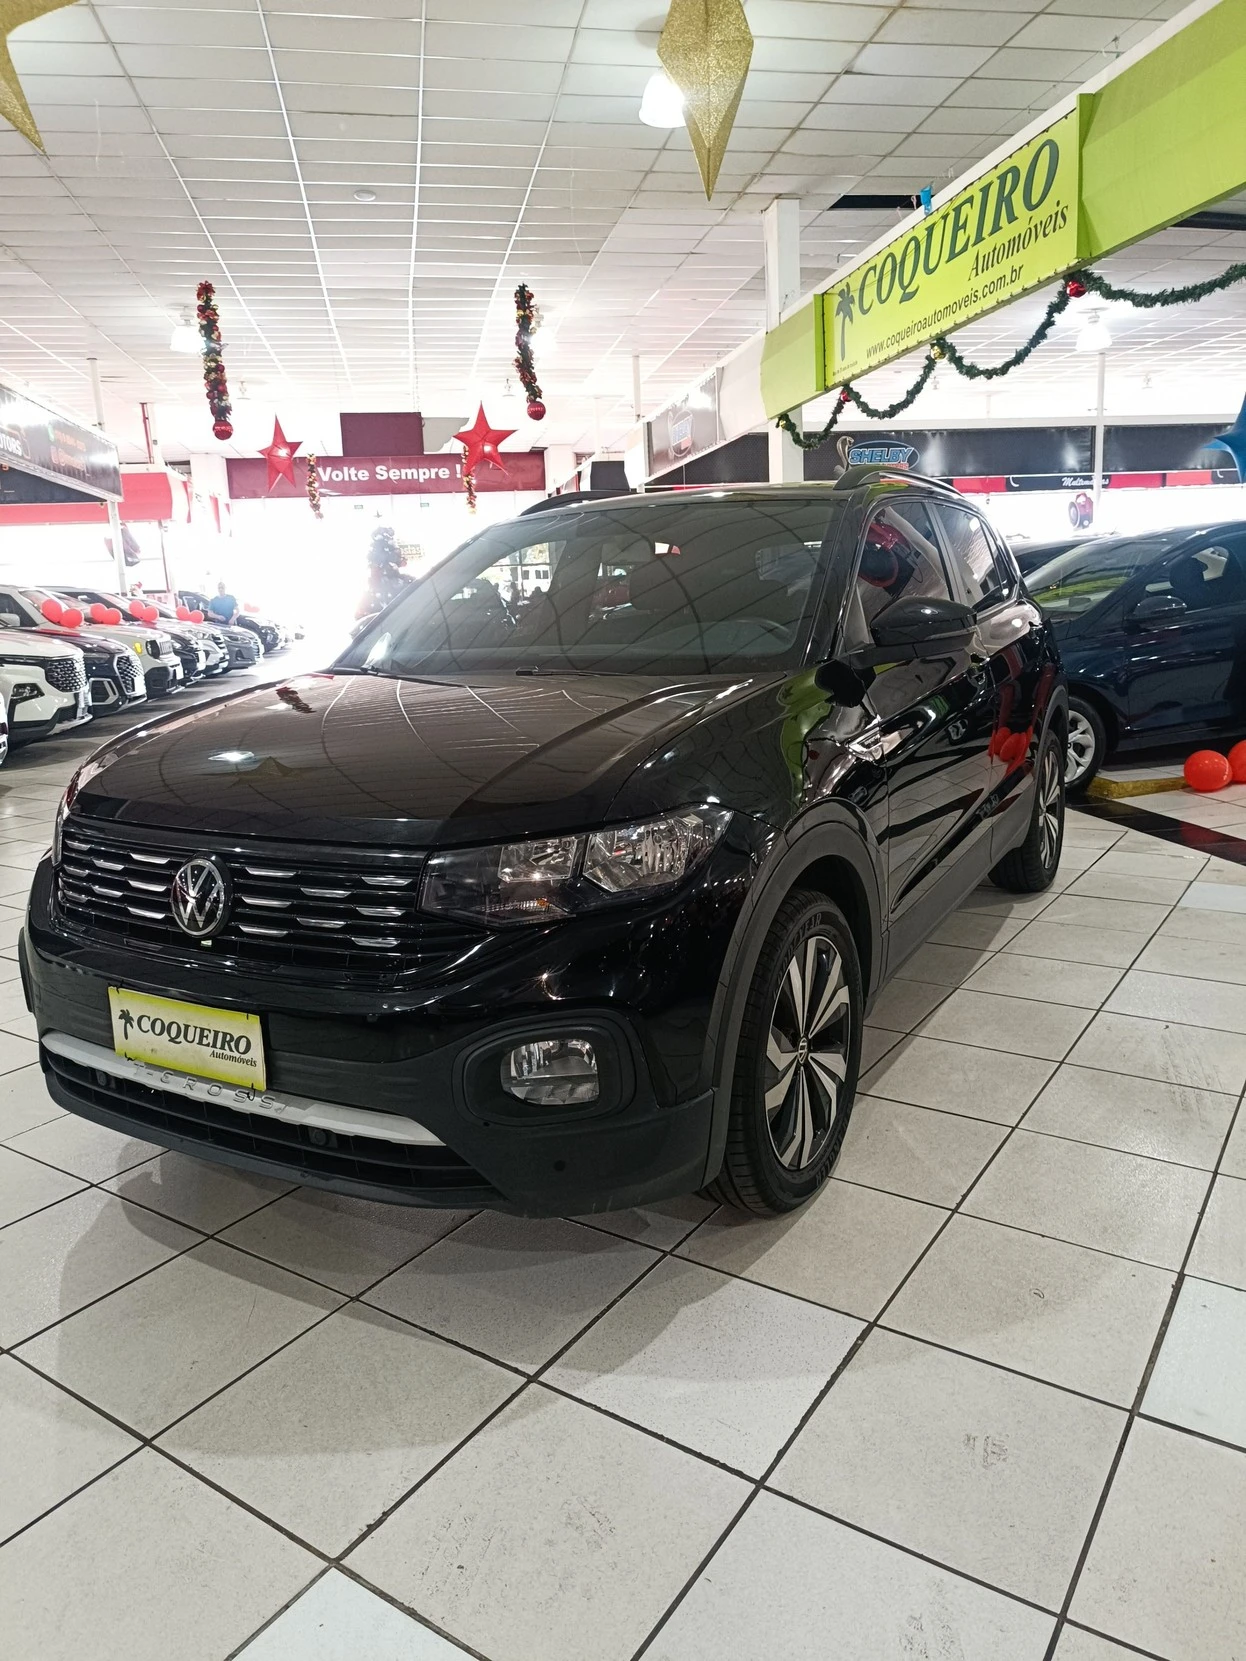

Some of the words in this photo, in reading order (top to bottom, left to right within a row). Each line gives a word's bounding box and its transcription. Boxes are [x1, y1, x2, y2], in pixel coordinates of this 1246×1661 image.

[858, 138, 1060, 316] COQUEIRO
[968, 200, 1069, 282] Automóveis
[866, 263, 1025, 360] www.coqueiroautomoveis.com.br
[318, 466, 369, 482] Volte
[375, 465, 450, 483] Sempre
[848, 447, 914, 464] SHELBY
[136, 1014, 252, 1055] COQUEIRO
[209, 1049, 258, 1068] Automóveis
